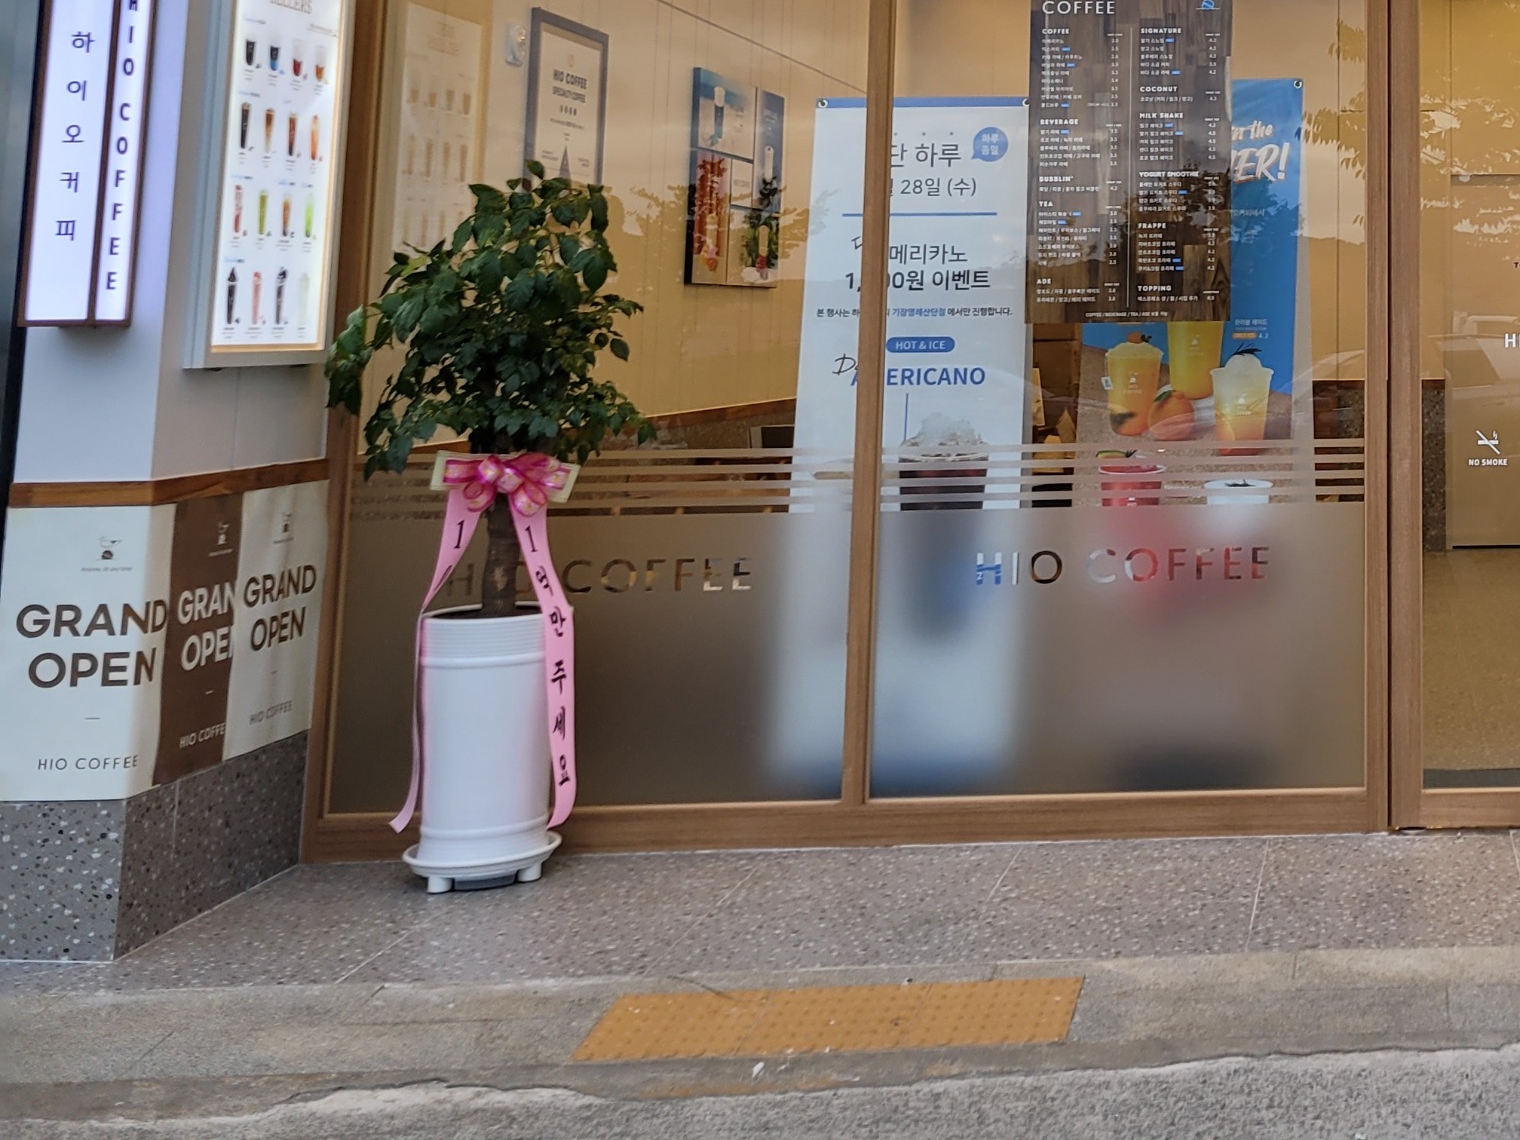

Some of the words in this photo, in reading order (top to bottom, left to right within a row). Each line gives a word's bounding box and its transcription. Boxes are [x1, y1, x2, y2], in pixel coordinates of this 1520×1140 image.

[1042, 0, 1116, 15] COFFEE
[54, 30, 96, 242] 하이오커피
[982, 133, 999, 144] 하루
[1250, 120, 1274, 140] the
[915, 143, 962, 168] 하루
[105, 101, 133, 291] COFFEE
[901, 178, 941, 197] 28일
[947, 177, 977, 197] (수)
[889, 243, 968, 265] 메리카노
[932, 272, 991, 291] 이벤트
[816, 308, 826, 318] 본
[827, 308, 851, 318] 행사는
[947, 308, 970, 317] 에서만
[972, 308, 1013, 317] 진행합니다.
[895, 340, 917, 350] HOT
[918, 340, 927, 350] &
[928, 340, 946, 350] ICE
[851, 366, 986, 387] ERICANO
[1468, 458, 1480, 466] NO
[1481, 458, 1508, 466] SMOKE
[566, 557, 753, 595] COFFEE
[975, 549, 1063, 586] HIO
[1084, 546, 1271, 584] COFFEE
[242, 564, 318, 608] GRAND
[15, 598, 169, 639] GRAND
[249, 606, 307, 652] OPEN
[27, 647, 157, 689] OPEN
[248, 707, 264, 726] HIO
[265, 699, 294, 722] COFFEE
[550, 658, 572, 788] 주세요
[179, 731, 197, 749] HIO
[37, 757, 69, 771] HIO
[75, 754, 140, 771] COFFEE
